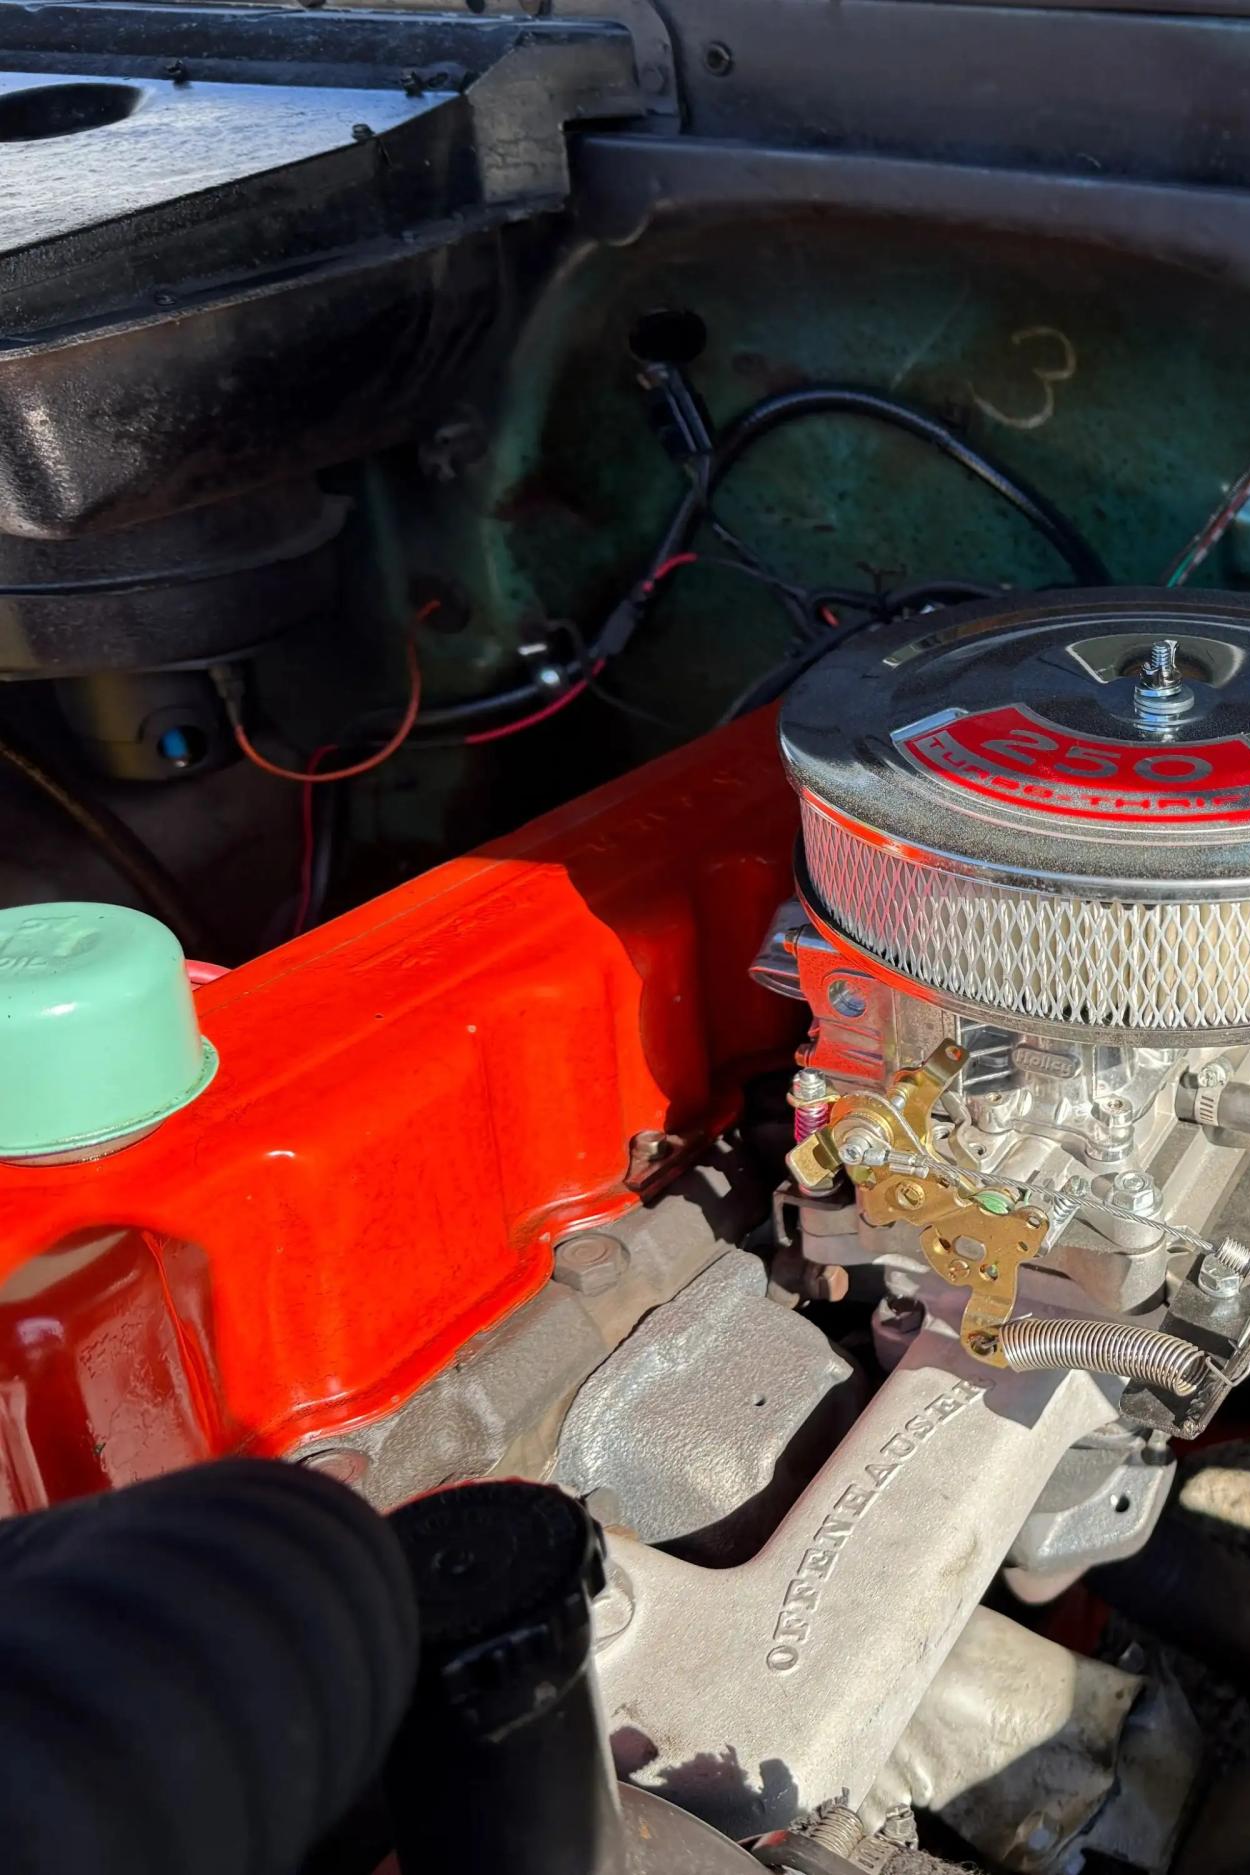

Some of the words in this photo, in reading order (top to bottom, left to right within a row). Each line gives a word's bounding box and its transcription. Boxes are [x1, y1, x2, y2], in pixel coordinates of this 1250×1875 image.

[968, 326, 1077, 429] 3
[984, 730, 1213, 783] 250
[766, 1378, 994, 1671] OFFENHAUSER
